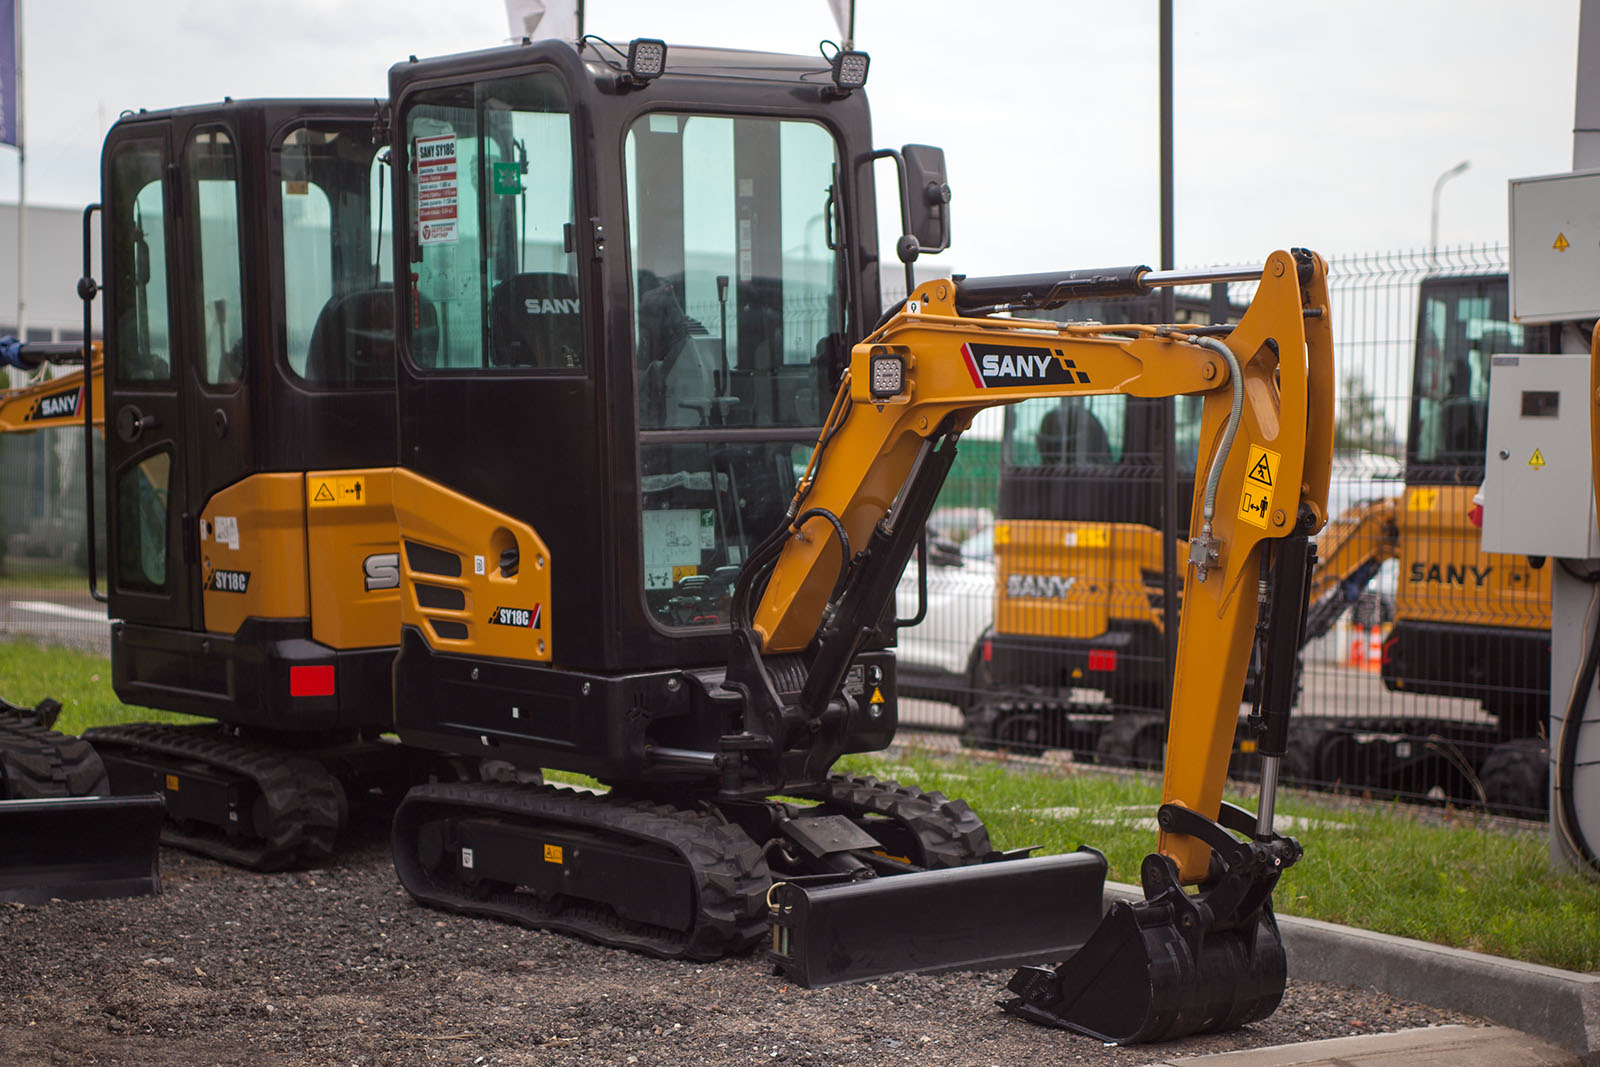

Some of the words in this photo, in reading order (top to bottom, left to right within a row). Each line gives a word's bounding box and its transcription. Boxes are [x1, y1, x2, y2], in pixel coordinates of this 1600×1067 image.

[420, 145, 434, 158] SANY
[524, 298, 580, 314] SANY
[981, 354, 1052, 378] SANY
[41, 394, 76, 416] SANY
[215, 571, 246, 591] SY18C
[1410, 562, 1492, 586] SANY
[1007, 573, 1077, 600] SANY
[500, 608, 529, 626] SY18C
